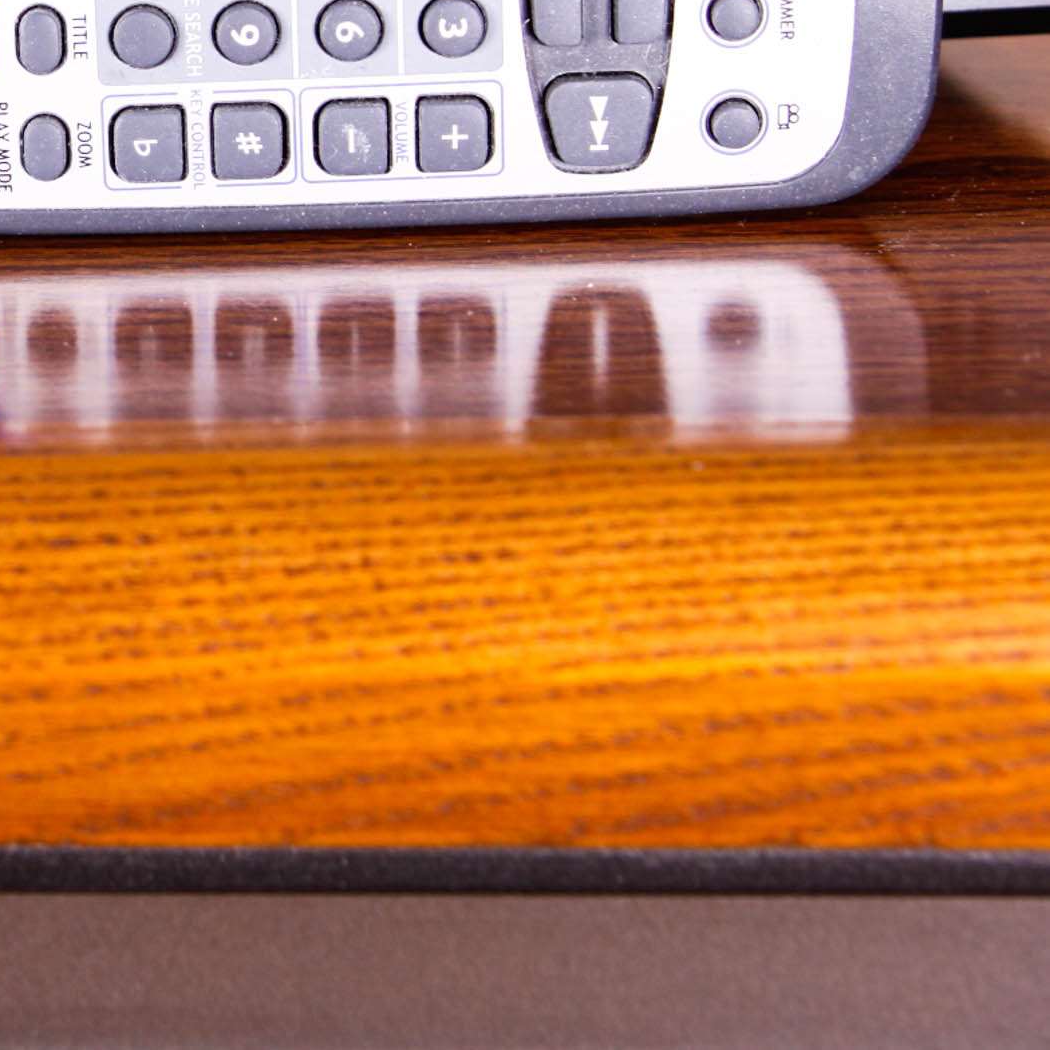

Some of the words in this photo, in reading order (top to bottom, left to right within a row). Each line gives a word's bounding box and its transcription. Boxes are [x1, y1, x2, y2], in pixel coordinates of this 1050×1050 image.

[72, 15, 88, 58] TITLE
[183, 14, 202, 77] SEARCH
[231, 25, 259, 46] 9
[336, 21, 364, 42] 6
[439, 18, 468, 38] 3
[191, 90, 203, 118] KEY
[77, 123, 92, 167] ZOOM
[395, 102, 409, 163] VOLUME
[191, 124, 205, 190] CONTROL
